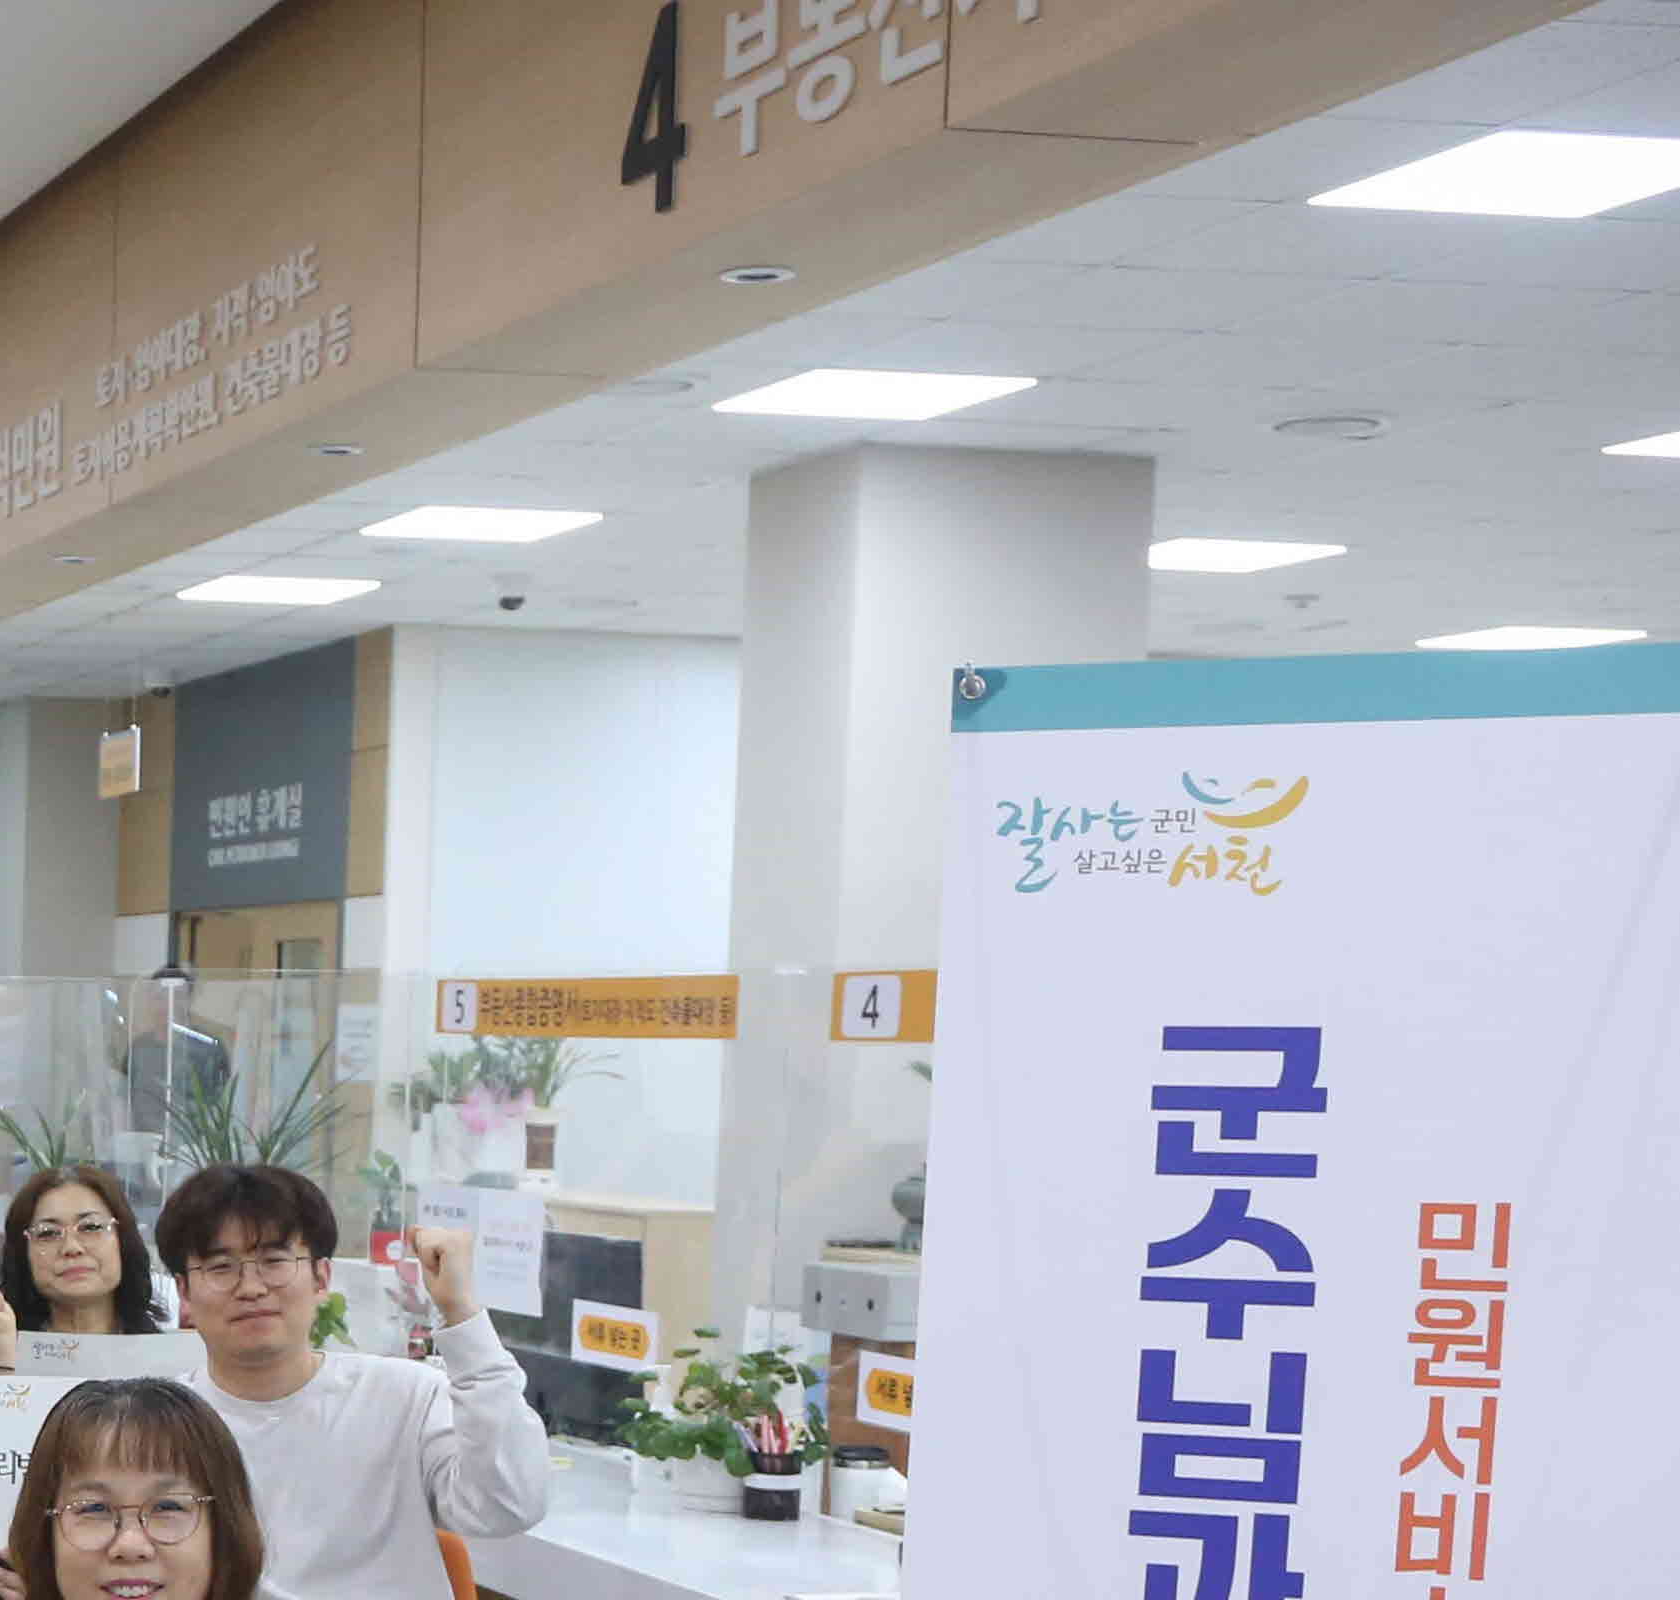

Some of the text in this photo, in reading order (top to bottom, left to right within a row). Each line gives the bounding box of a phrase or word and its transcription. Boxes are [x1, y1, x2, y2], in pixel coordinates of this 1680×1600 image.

[622, 0, 1041, 213] 4 부동산
[328, 303, 352, 366] 등
[996, 796, 1198, 893] 잘사는 군민
[1072, 834, 1284, 896] 살고싶은 서천
[454, 989, 466, 1025] 5
[860, 984, 880, 1030] 4
